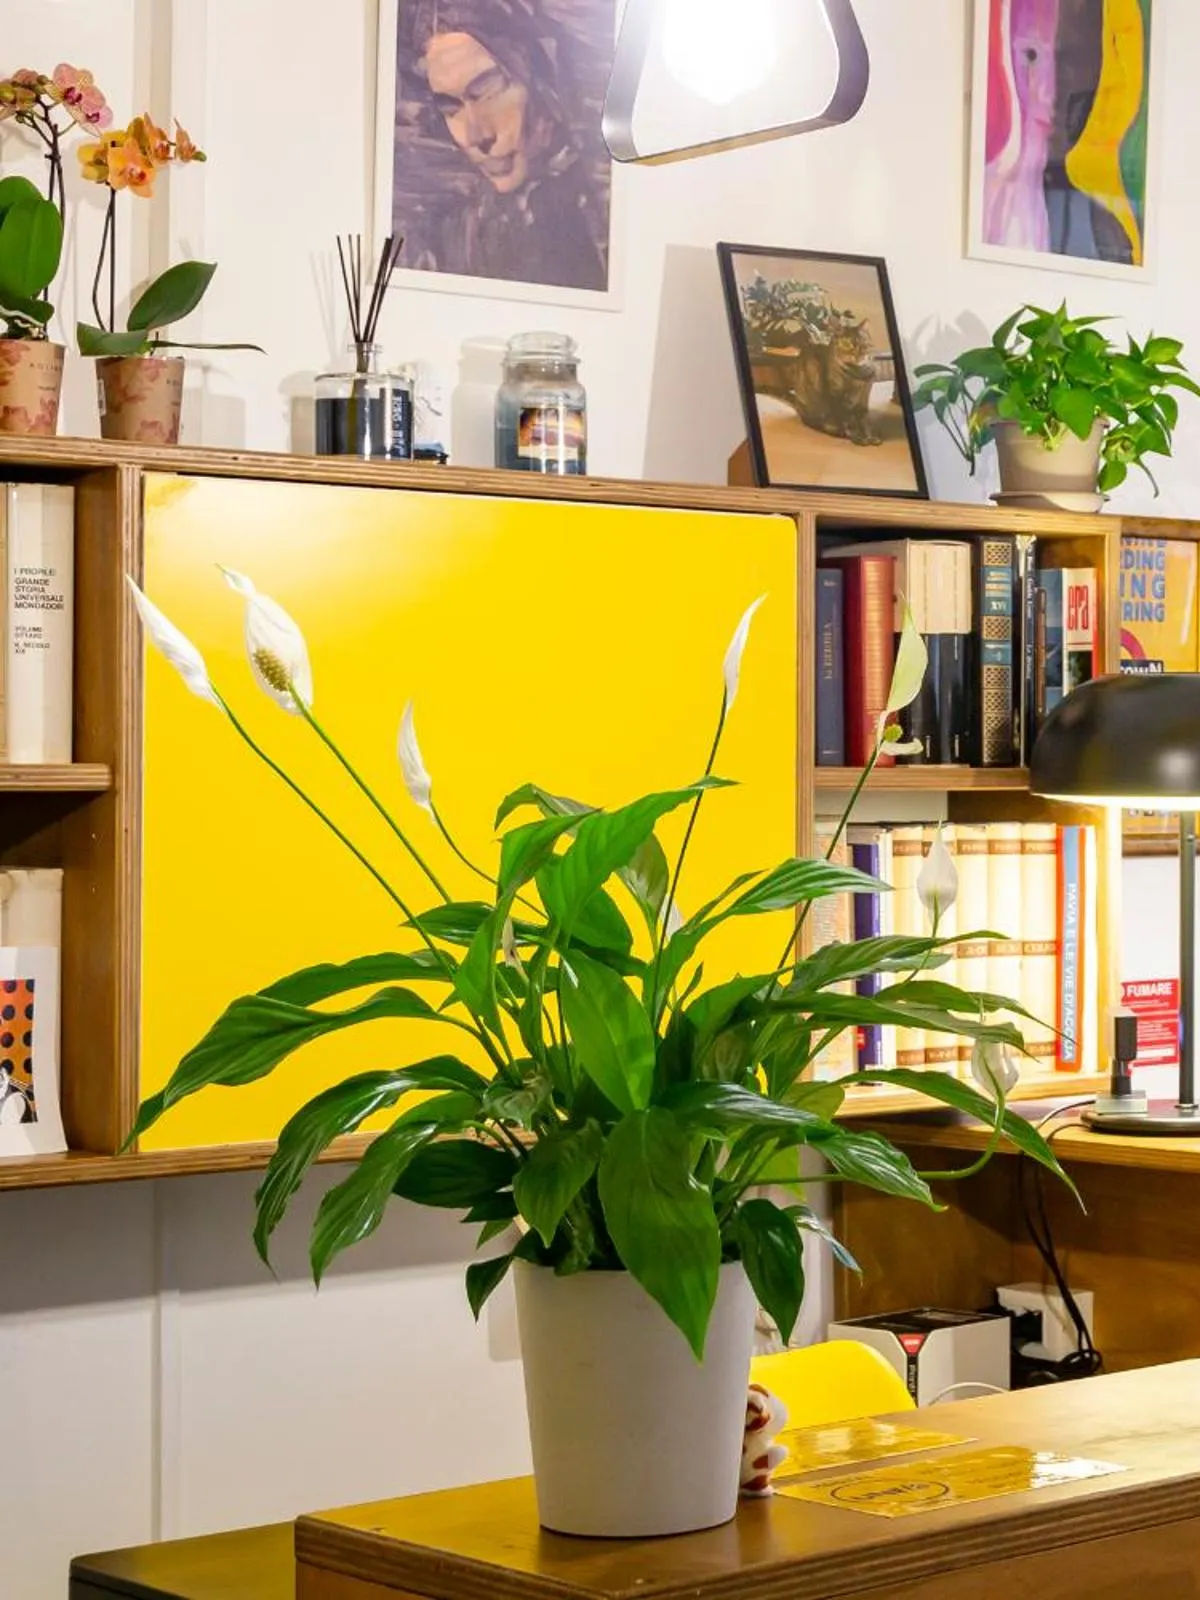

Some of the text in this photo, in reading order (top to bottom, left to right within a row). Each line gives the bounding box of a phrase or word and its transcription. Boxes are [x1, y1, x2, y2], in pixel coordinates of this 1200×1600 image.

[15, 578, 50, 586] GRANDE
[14, 594, 64, 602] UNIVERSALE
[1127, 983, 1172, 997] FUMARE
